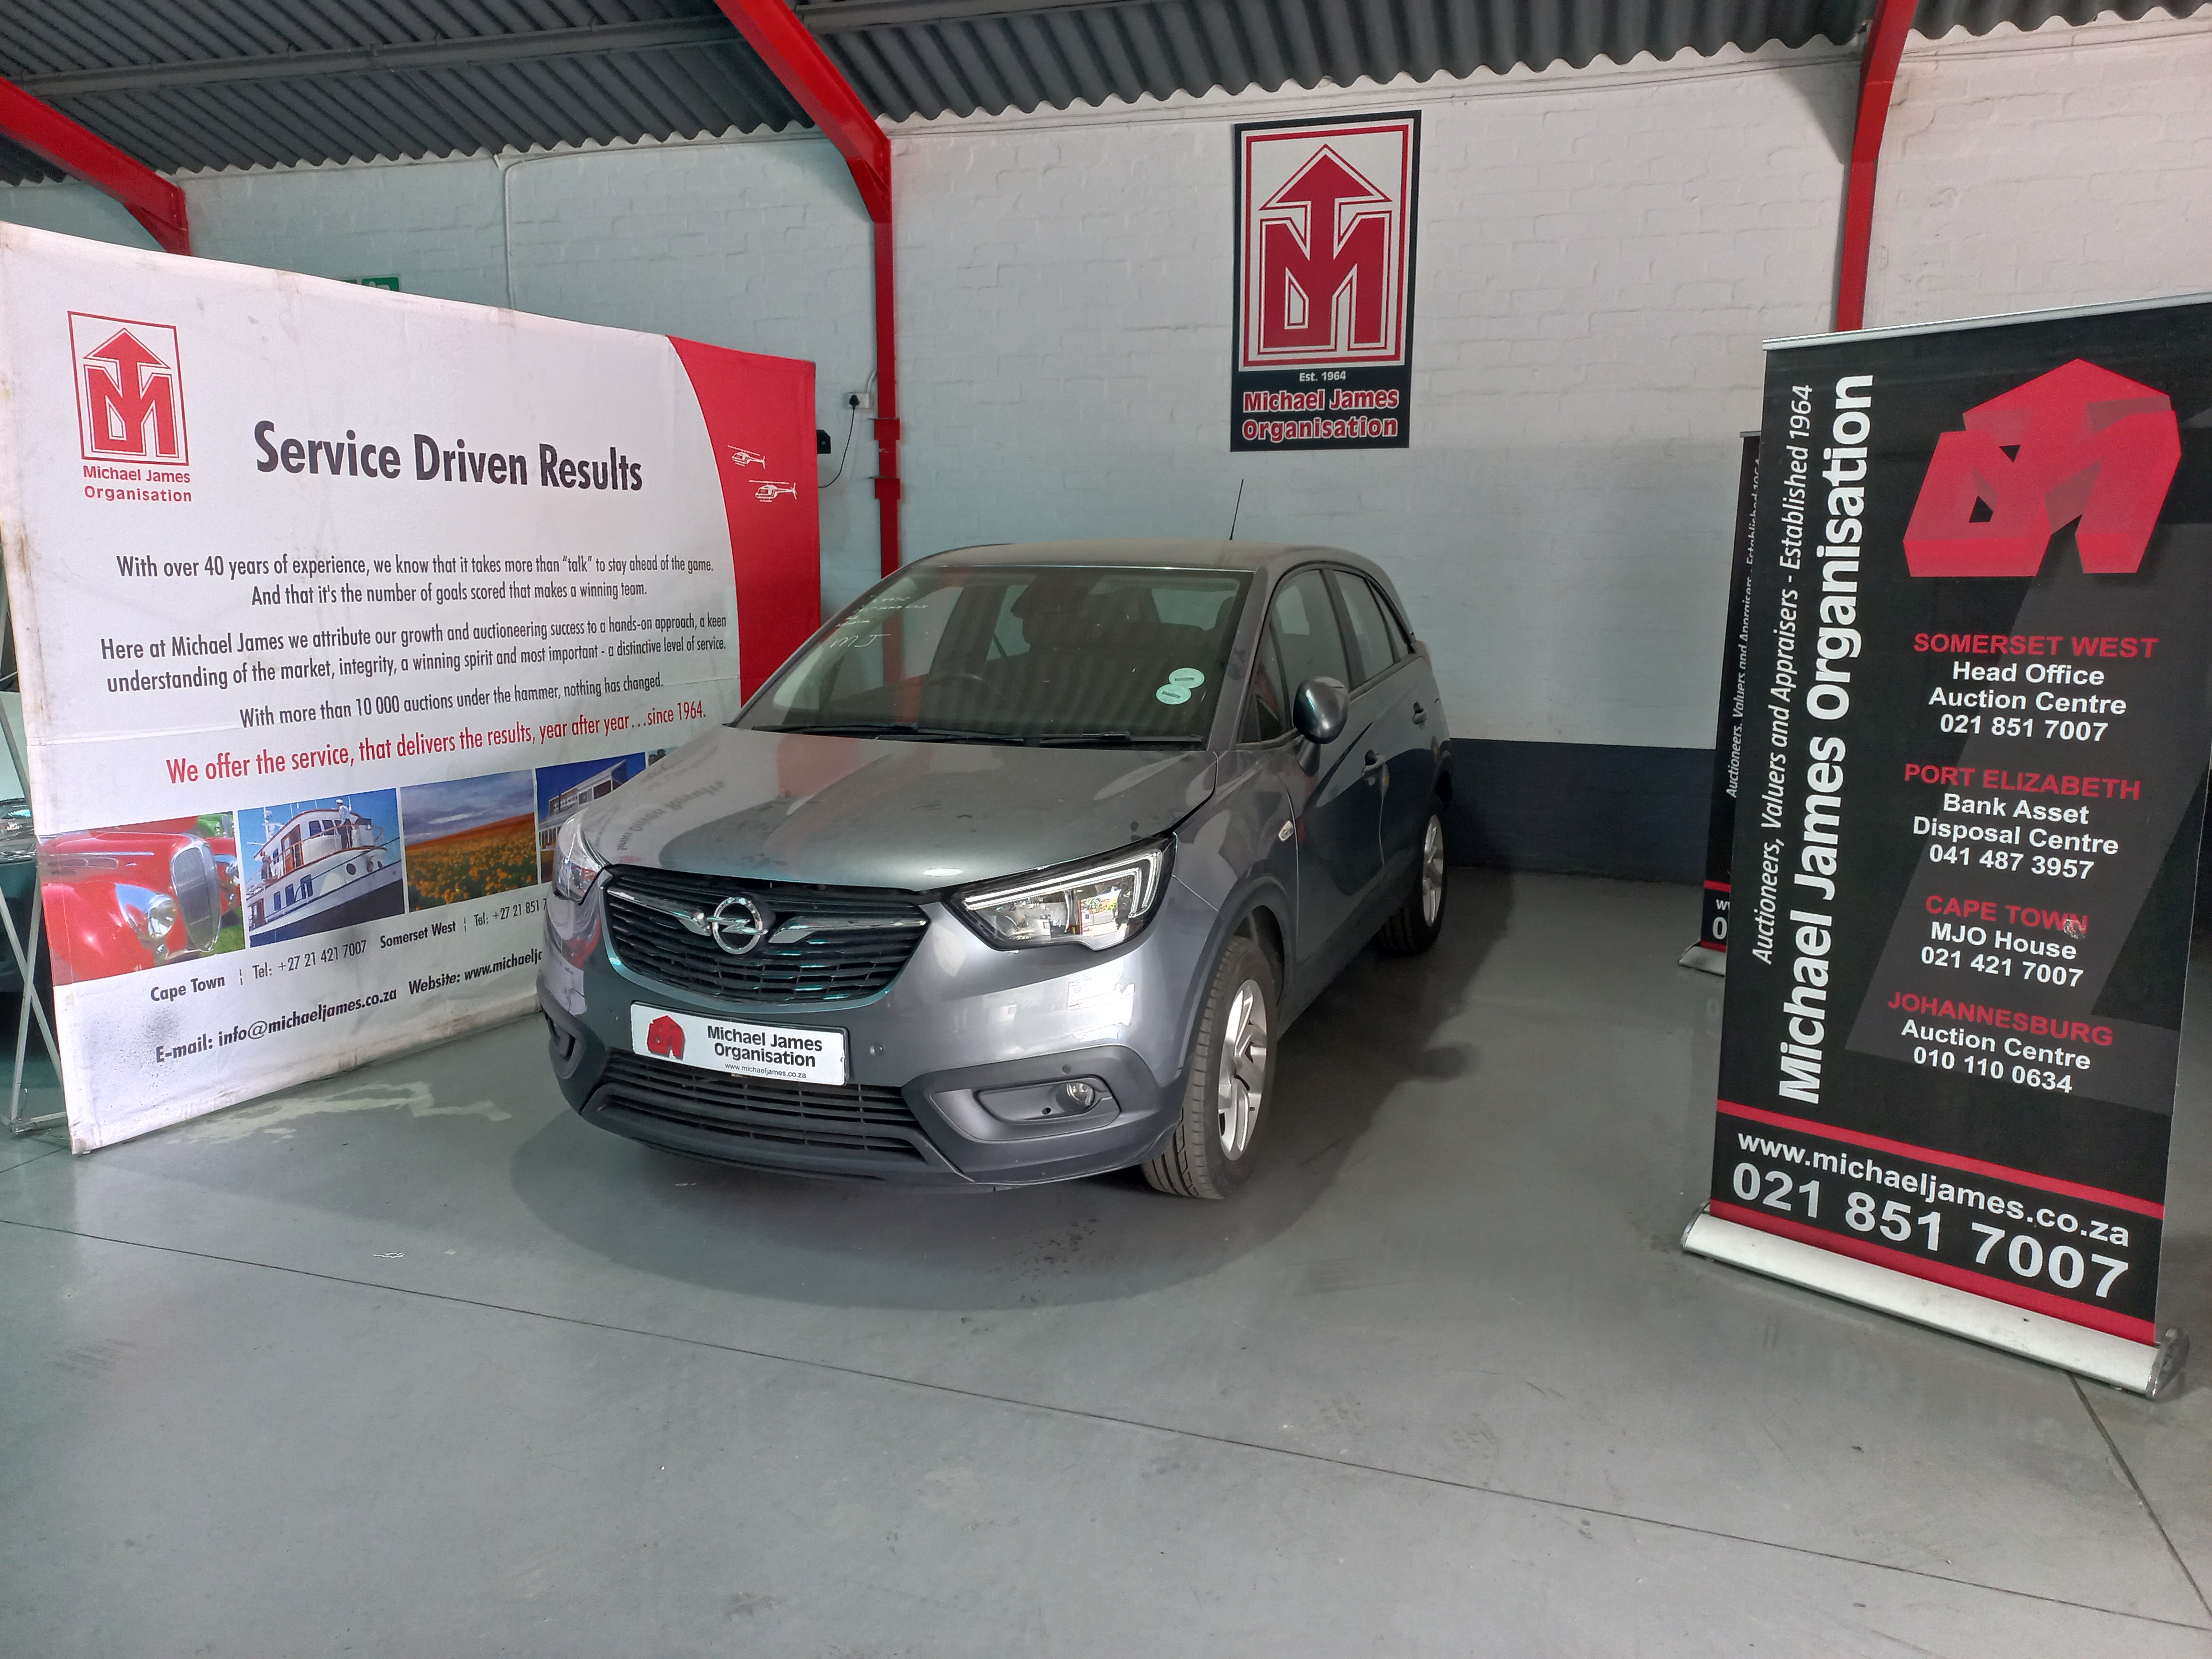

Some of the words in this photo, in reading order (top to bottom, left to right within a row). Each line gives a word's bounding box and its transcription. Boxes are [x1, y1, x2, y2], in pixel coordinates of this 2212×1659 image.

[1300, 373, 1318, 381] Est.
[1322, 371, 1346, 380] 1964
[1243, 389, 1325, 412] Michael
[1329, 389, 1399, 409] James
[1790, 385, 1812, 438] 1964
[1242, 416, 1398, 443] Organisation
[83, 466, 141, 480] Michael
[146, 470, 190, 483] James
[254, 420, 400, 478] Service
[414, 434, 527, 485] Driven
[540, 444, 642, 490] Results
[85, 486, 191, 501] Organisation
[1780, 445, 1808, 569] Established
[117, 555, 157, 576] With
[164, 563, 199, 576] over
[205, 556, 223, 575] 40
[229, 561, 269, 580] years
[274, 553, 288, 574] of
[293, 556, 369, 578] experience,
[374, 561, 391, 573] we
[396, 554, 428, 573] know
[432, 555, 456, 573] that
[460, 556, 467, 572] it
[472, 555, 501, 572] takes
[505, 561, 532, 572] more
[536, 555, 559, 572] than
[596, 559, 605, 572] to
[608, 559, 626, 575] stay
[630, 555, 657, 571] ahead
[661, 554, 668, 570] of
[672, 556, 685, 570] the
[688, 561, 714, 574] game.
[1807, 376, 1873, 719] Organisation
[252, 585, 280, 605] And
[286, 584, 313, 604] that
[318, 585, 336, 603] it's
[341, 583, 362, 602] the
[367, 583, 416, 601] number
[421, 583, 431, 601] of
[436, 582, 467, 605] goals
[471, 581, 505, 599] scored
[509, 581, 531, 598] that
[535, 581, 567, 597] makes
[580, 582, 618, 599] winning
[621, 583, 647, 596] team.
[101, 639, 143, 659] Here
[150, 640, 166, 657] at
[172, 633, 232, 656] Michael
[237, 633, 284, 652] James
[288, 635, 308, 648] we
[313, 627, 370, 647] attribute
[376, 631, 396, 644] our
[401, 624, 443, 647] growth
[448, 622, 469, 640] and
[474, 621, 547, 640] auctioneering
[551, 623, 584, 635] success
[587, 621, 597, 633] to
[609, 615, 652, 632] hands-on
[655, 613, 697, 632] approach,
[708, 613, 726, 627] keen
[1771, 589, 1798, 702] Appraisers
[1914, 633, 2063, 655] SOMERSET
[2072, 637, 2159, 657] WEST
[1954, 662, 2017, 681] Head
[2026, 664, 2104, 685] Office
[240, 706, 274, 728] With
[280, 708, 316, 723] more
[321, 701, 351, 719] than
[356, 697, 371, 716] 10
[376, 696, 399, 714] 000
[404, 694, 453, 711] auctions
[457, 688, 489, 707] under
[493, 686, 510, 703] the
[515, 685, 560, 701] hammer,
[564, 680, 601, 697] nothing
[605, 677, 620, 693] has
[623, 672, 663, 691] changed.
[1929, 687, 2026, 709] Auction
[2036, 692, 2126, 714] Centre
[166, 758, 198, 783] We
[206, 752, 250, 779] offer
[256, 749, 285, 774] the
[292, 744, 354, 769] service,
[359, 738, 391, 761] that
[398, 732, 455, 756] delivers
[460, 727, 482, 749] the
[488, 721, 535, 745] results,
[540, 724, 567, 744] year
[572, 715, 599, 735] after
[678, 701, 706, 719] 1964.
[1769, 705, 1789, 747] and
[1941, 714, 1980, 733] 021
[1992, 717, 2033, 737] 851
[2046, 720, 2108, 741] 7007
[1761, 752, 1786, 828] Valuers
[1905, 763, 1976, 786] PORT
[1984, 770, 2140, 799] ELIZABETH
[1794, 737, 1846, 900] James
[1944, 794, 2006, 816] Bank
[2013, 800, 2089, 824] Asset
[1914, 817, 2020, 844] Disposal
[2030, 829, 2118, 854] Centre
[1930, 844, 1969, 865] 041
[1980, 850, 2024, 871] 487
[2032, 856, 2094, 879] 3957
[1753, 839, 1784, 964] Auctioneers,
[1926, 896, 1997, 921] CAPE
[2007, 906, 2088, 934] TOWN
[151, 986, 186, 1001] Cape
[191, 977, 225, 992] Town
[253, 962, 272, 978] Tel:
[279, 955, 300, 971] +27
[305, 952, 315, 967] 21
[321, 947, 338, 962] 421
[343, 940, 366, 957] 7007
[380, 928, 428, 948] Somerset
[431, 921, 455, 936] West
[474, 912, 489, 926] Tel:
[494, 907, 509, 919] +27
[513, 904, 521, 917] 21
[526, 900, 539, 914] 851
[1932, 922, 1986, 945] MJO
[1995, 931, 2076, 959] House
[1922, 947, 1960, 968] 021
[1971, 954, 2011, 976] 421
[2023, 962, 2083, 986] 7007
[156, 1034, 212, 1062] E-mail:
[219, 989, 397, 1046] info@michaeljames.co.za
[409, 974, 460, 994] Website:
[1779, 910, 1832, 1104] Michael
[1888, 992, 2112, 1046] JOHANNESBURG
[708, 1026, 765, 1045] Michael
[771, 1034, 822, 1051] James
[715, 1042, 816, 1067] Organisation
[1902, 1019, 1995, 1051] Auction
[2005, 1038, 2090, 1069] Centre
[725, 1063, 806, 1079] www.michaeljames.co.za
[1914, 1047, 1955, 1069] 010
[1965, 1056, 2003, 1078] 110
[2013, 1066, 2072, 1093] 0634
[1737, 1132, 2129, 1247] www.michaeljames.co.za
[1734, 1161, 1819, 1218] 021
[1846, 1192, 1940, 1251] 851
[1972, 1221, 2128, 1297] 7007
